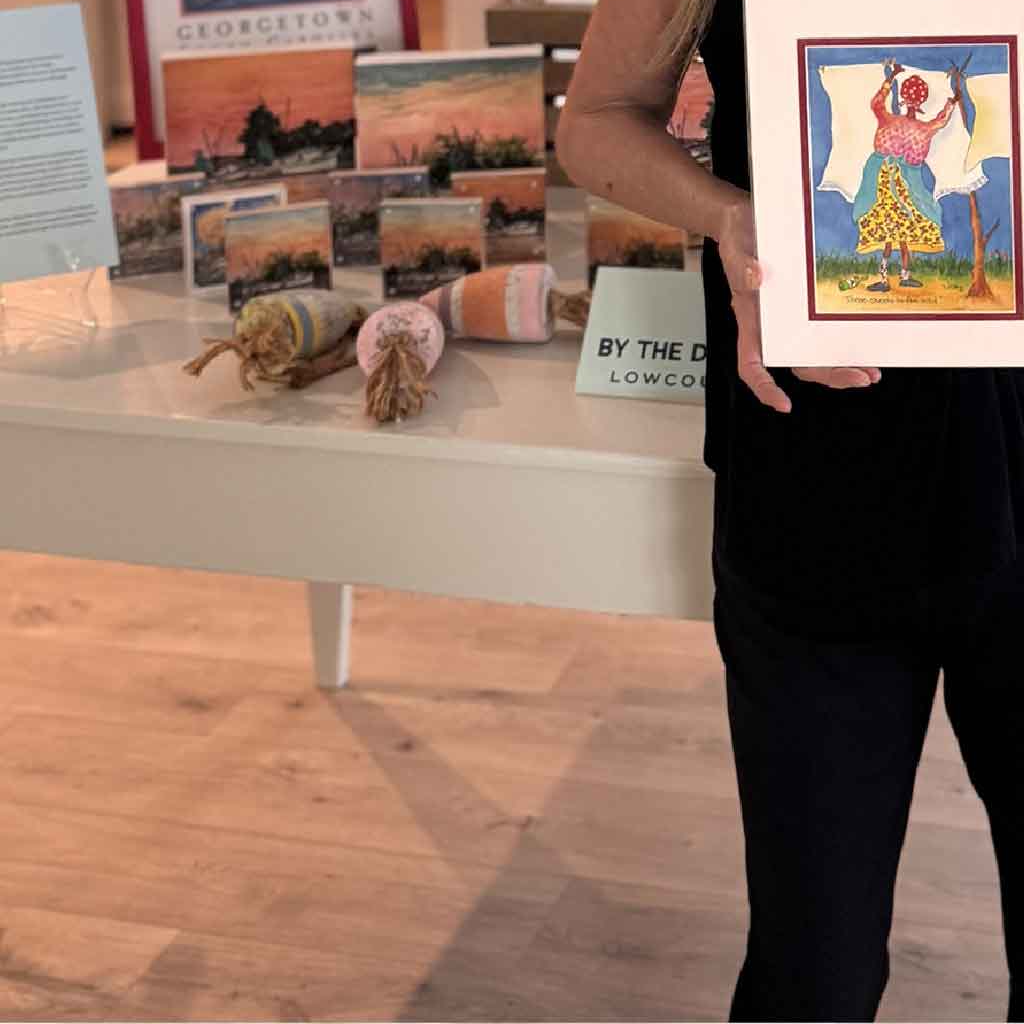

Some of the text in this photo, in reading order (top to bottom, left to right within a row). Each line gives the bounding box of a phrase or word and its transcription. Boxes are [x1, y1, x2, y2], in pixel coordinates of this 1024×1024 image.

[177, 8, 374, 41] GEORGETOWN
[598, 337, 630, 358] BY
[637, 339, 684, 361] THE
